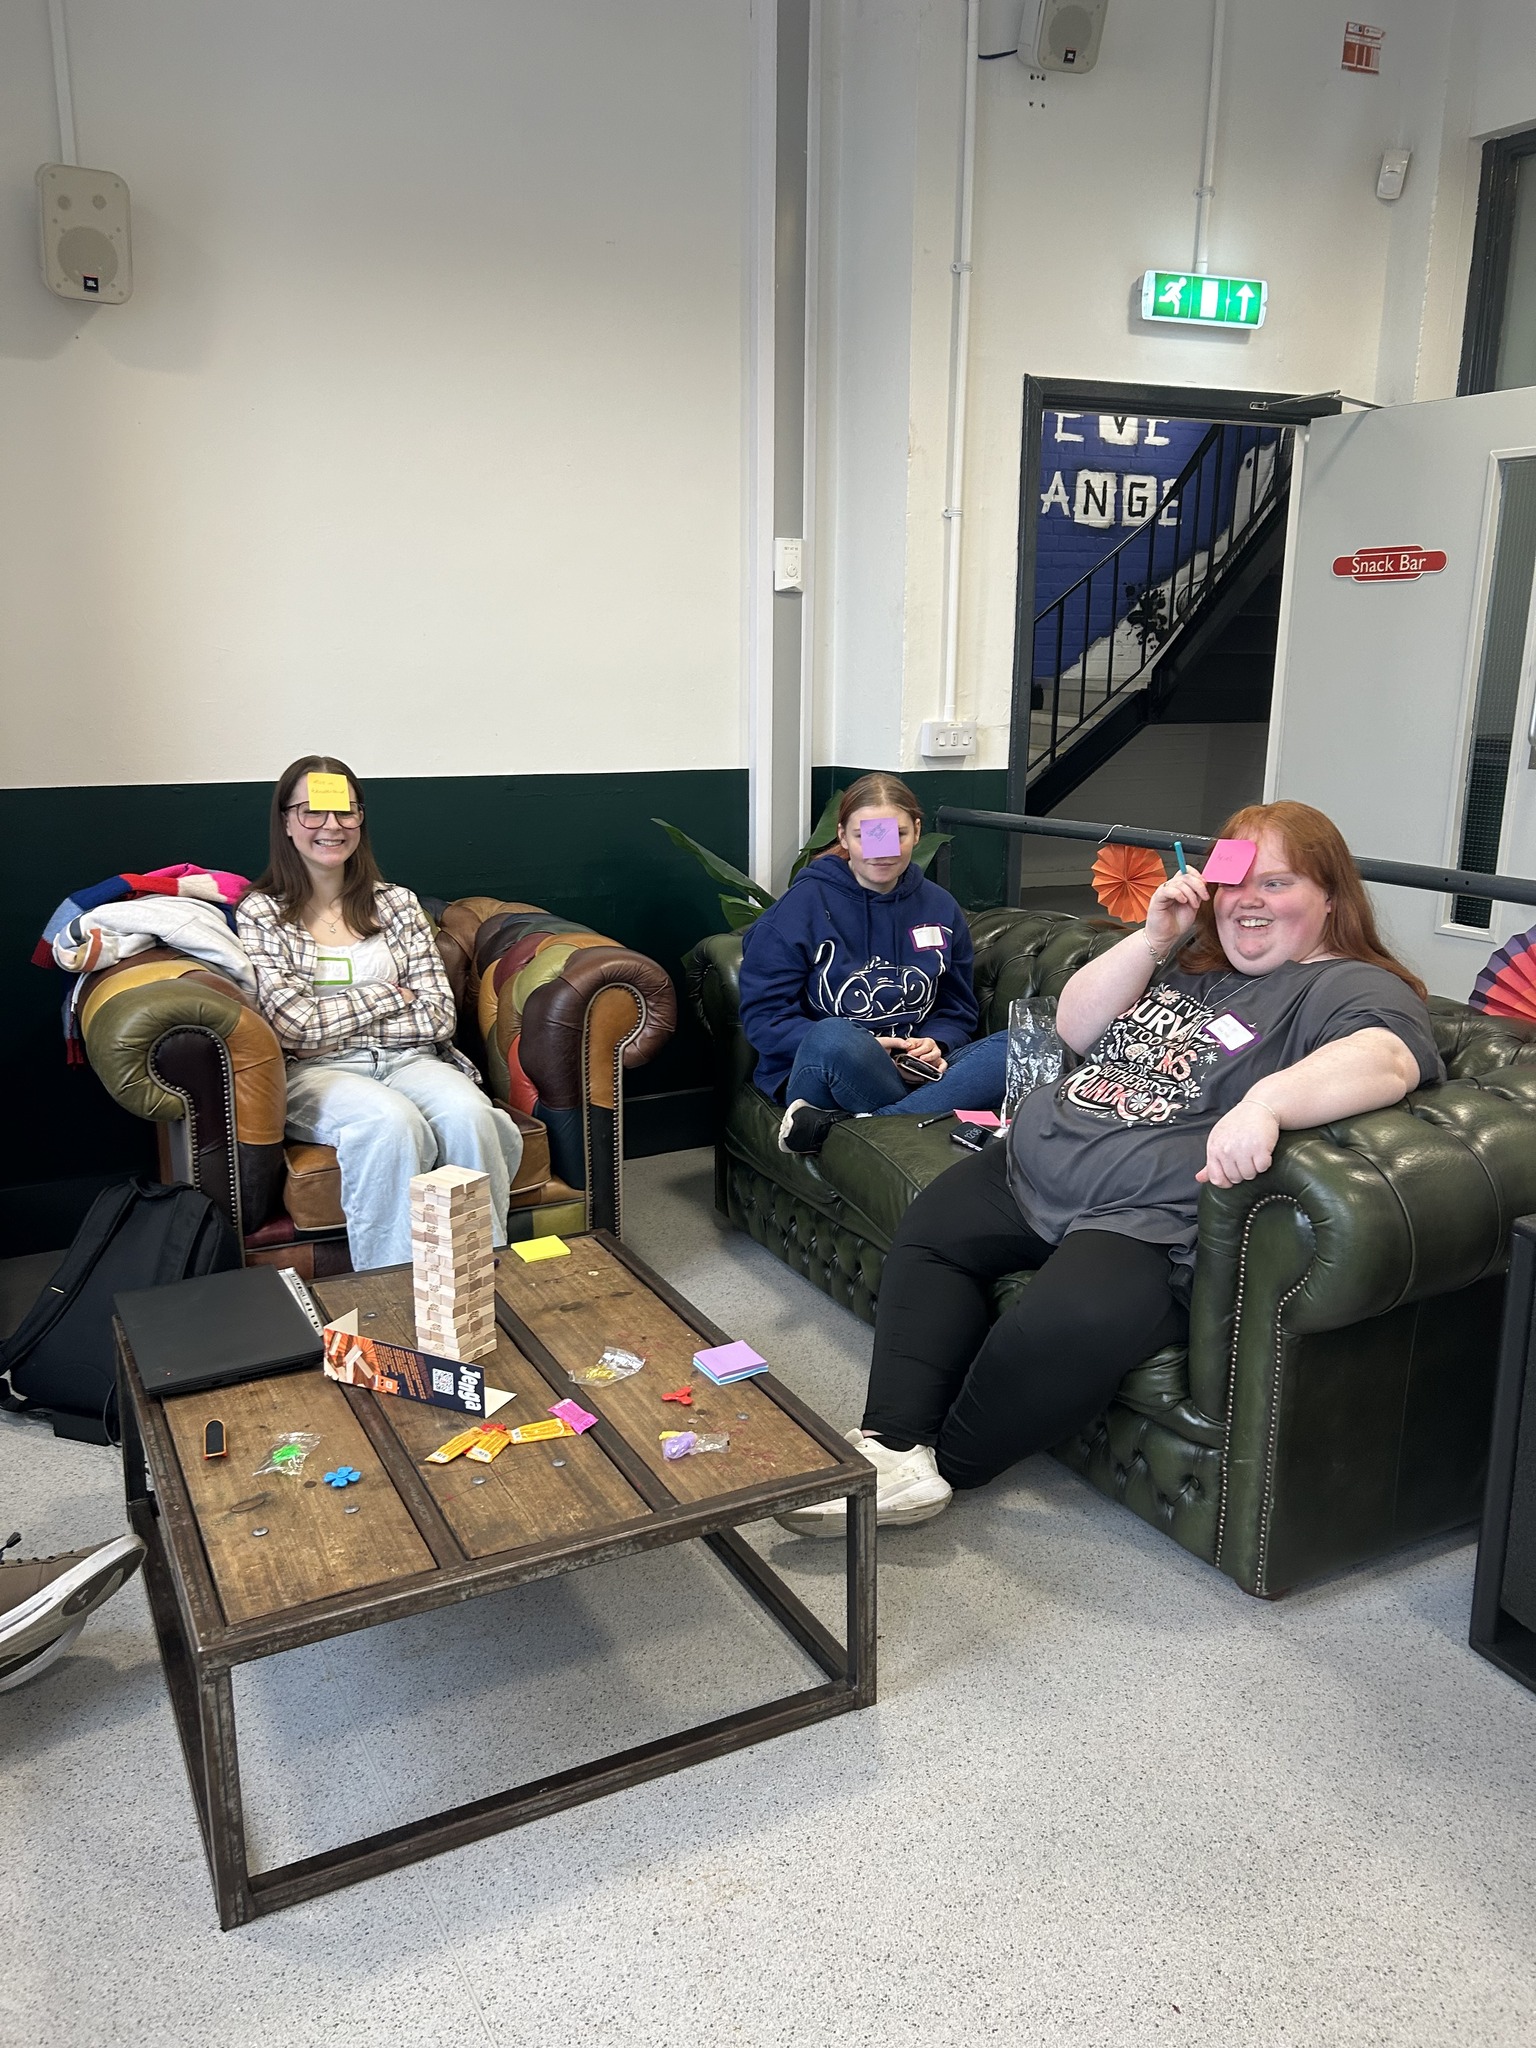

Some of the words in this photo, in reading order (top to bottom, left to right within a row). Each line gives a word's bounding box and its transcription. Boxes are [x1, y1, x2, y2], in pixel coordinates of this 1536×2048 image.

[1351, 555, 1395, 574] Snack
[1399, 554, 1427, 572] Bar
[1131, 1025, 1163, 1046] TOO
[457, 1365, 482, 1411] Jenga
